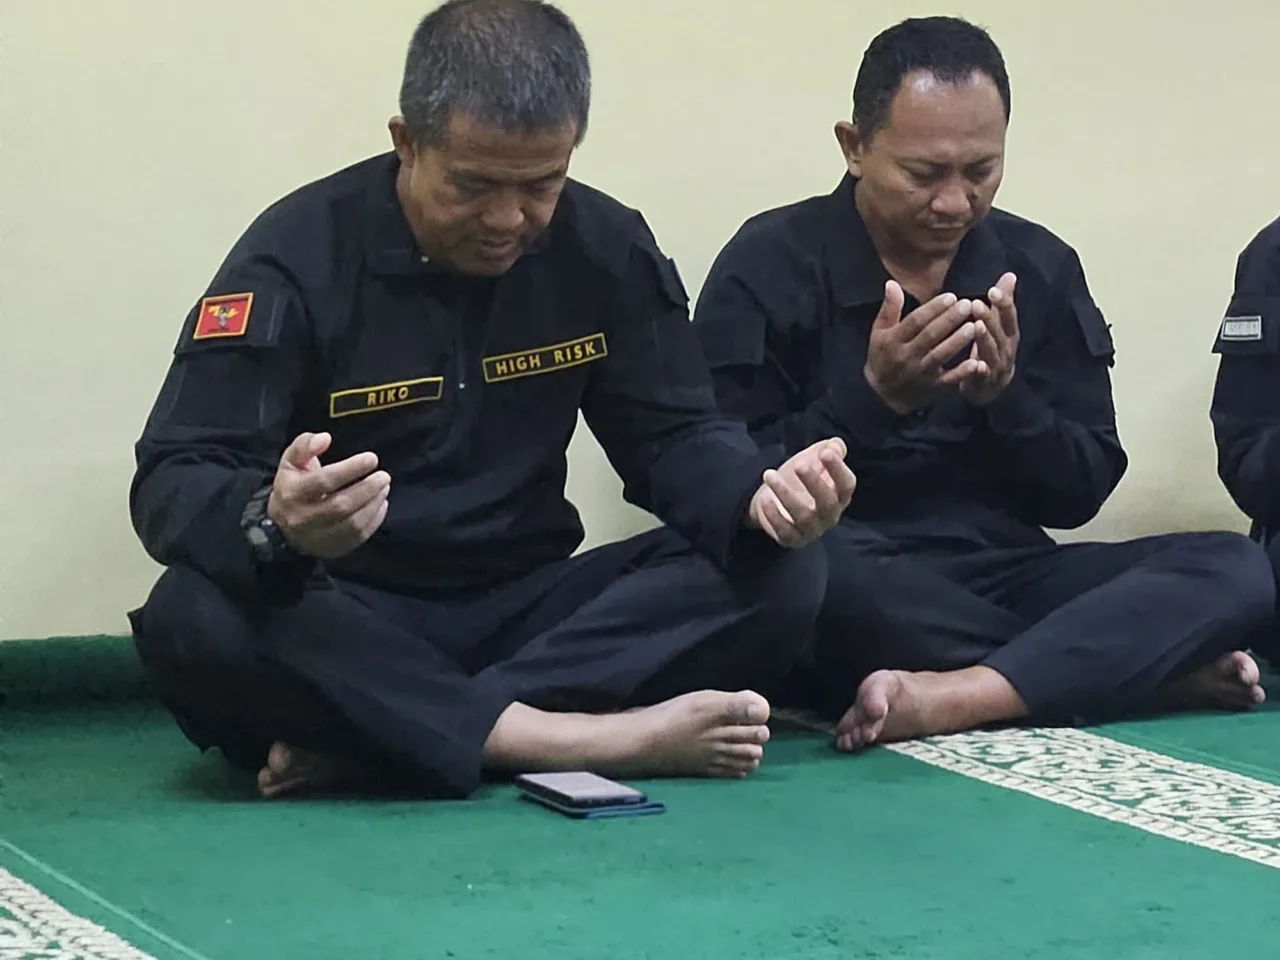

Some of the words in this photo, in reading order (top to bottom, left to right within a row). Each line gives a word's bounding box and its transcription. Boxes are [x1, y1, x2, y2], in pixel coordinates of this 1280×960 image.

[495, 354, 541, 376] HIGH
[553, 341, 596, 364] RISK
[367, 386, 409, 406] RIKO
